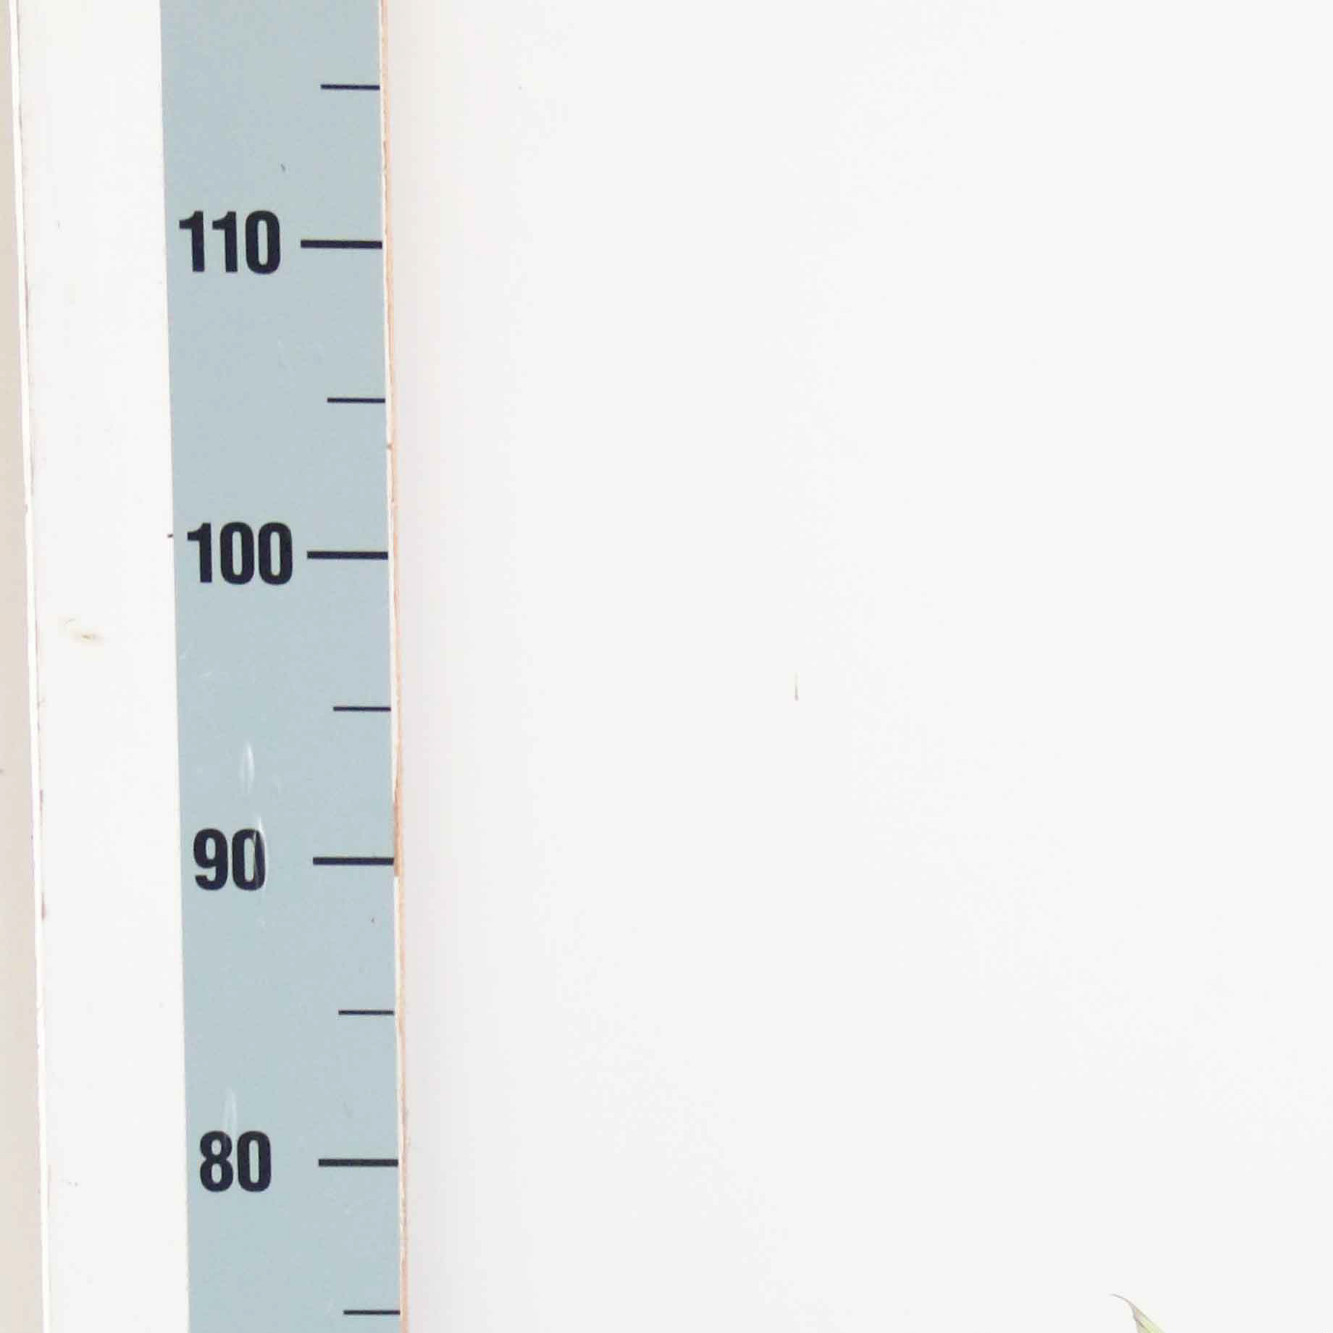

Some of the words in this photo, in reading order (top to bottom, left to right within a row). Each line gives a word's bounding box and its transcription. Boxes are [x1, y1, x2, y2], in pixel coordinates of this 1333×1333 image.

[180, 211, 280, 274] 110
[187, 523, 292, 584] 100
[194, 829, 265, 890] 90
[199, 1131, 271, 1191] 80
